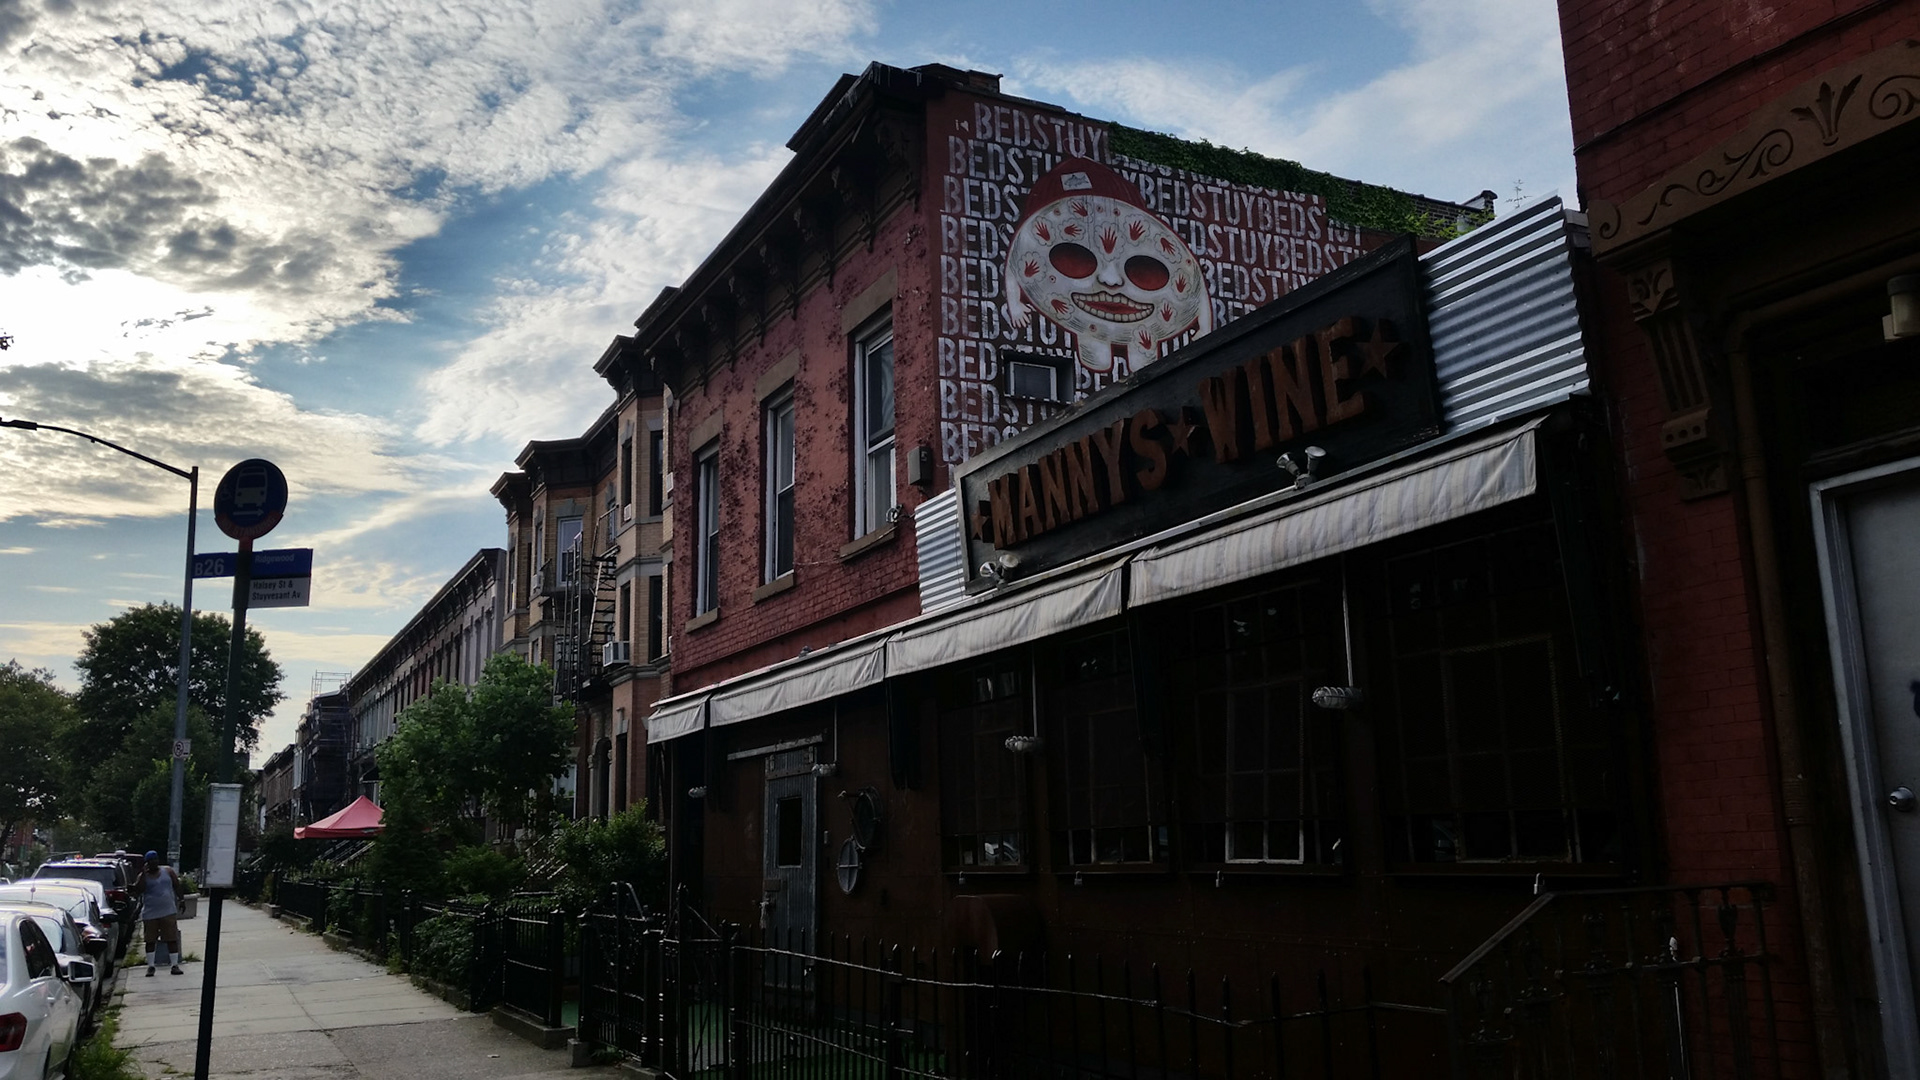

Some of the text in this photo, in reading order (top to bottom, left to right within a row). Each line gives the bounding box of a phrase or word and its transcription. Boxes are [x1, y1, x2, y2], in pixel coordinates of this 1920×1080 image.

[986, 315, 1372, 550] MANNYS WINE
[255, 554, 295, 564] Ridgewood
[194, 558, 225, 576] B26
[253, 580, 277, 590] Halsey
[252, 592, 290, 601] Stuyvesant
